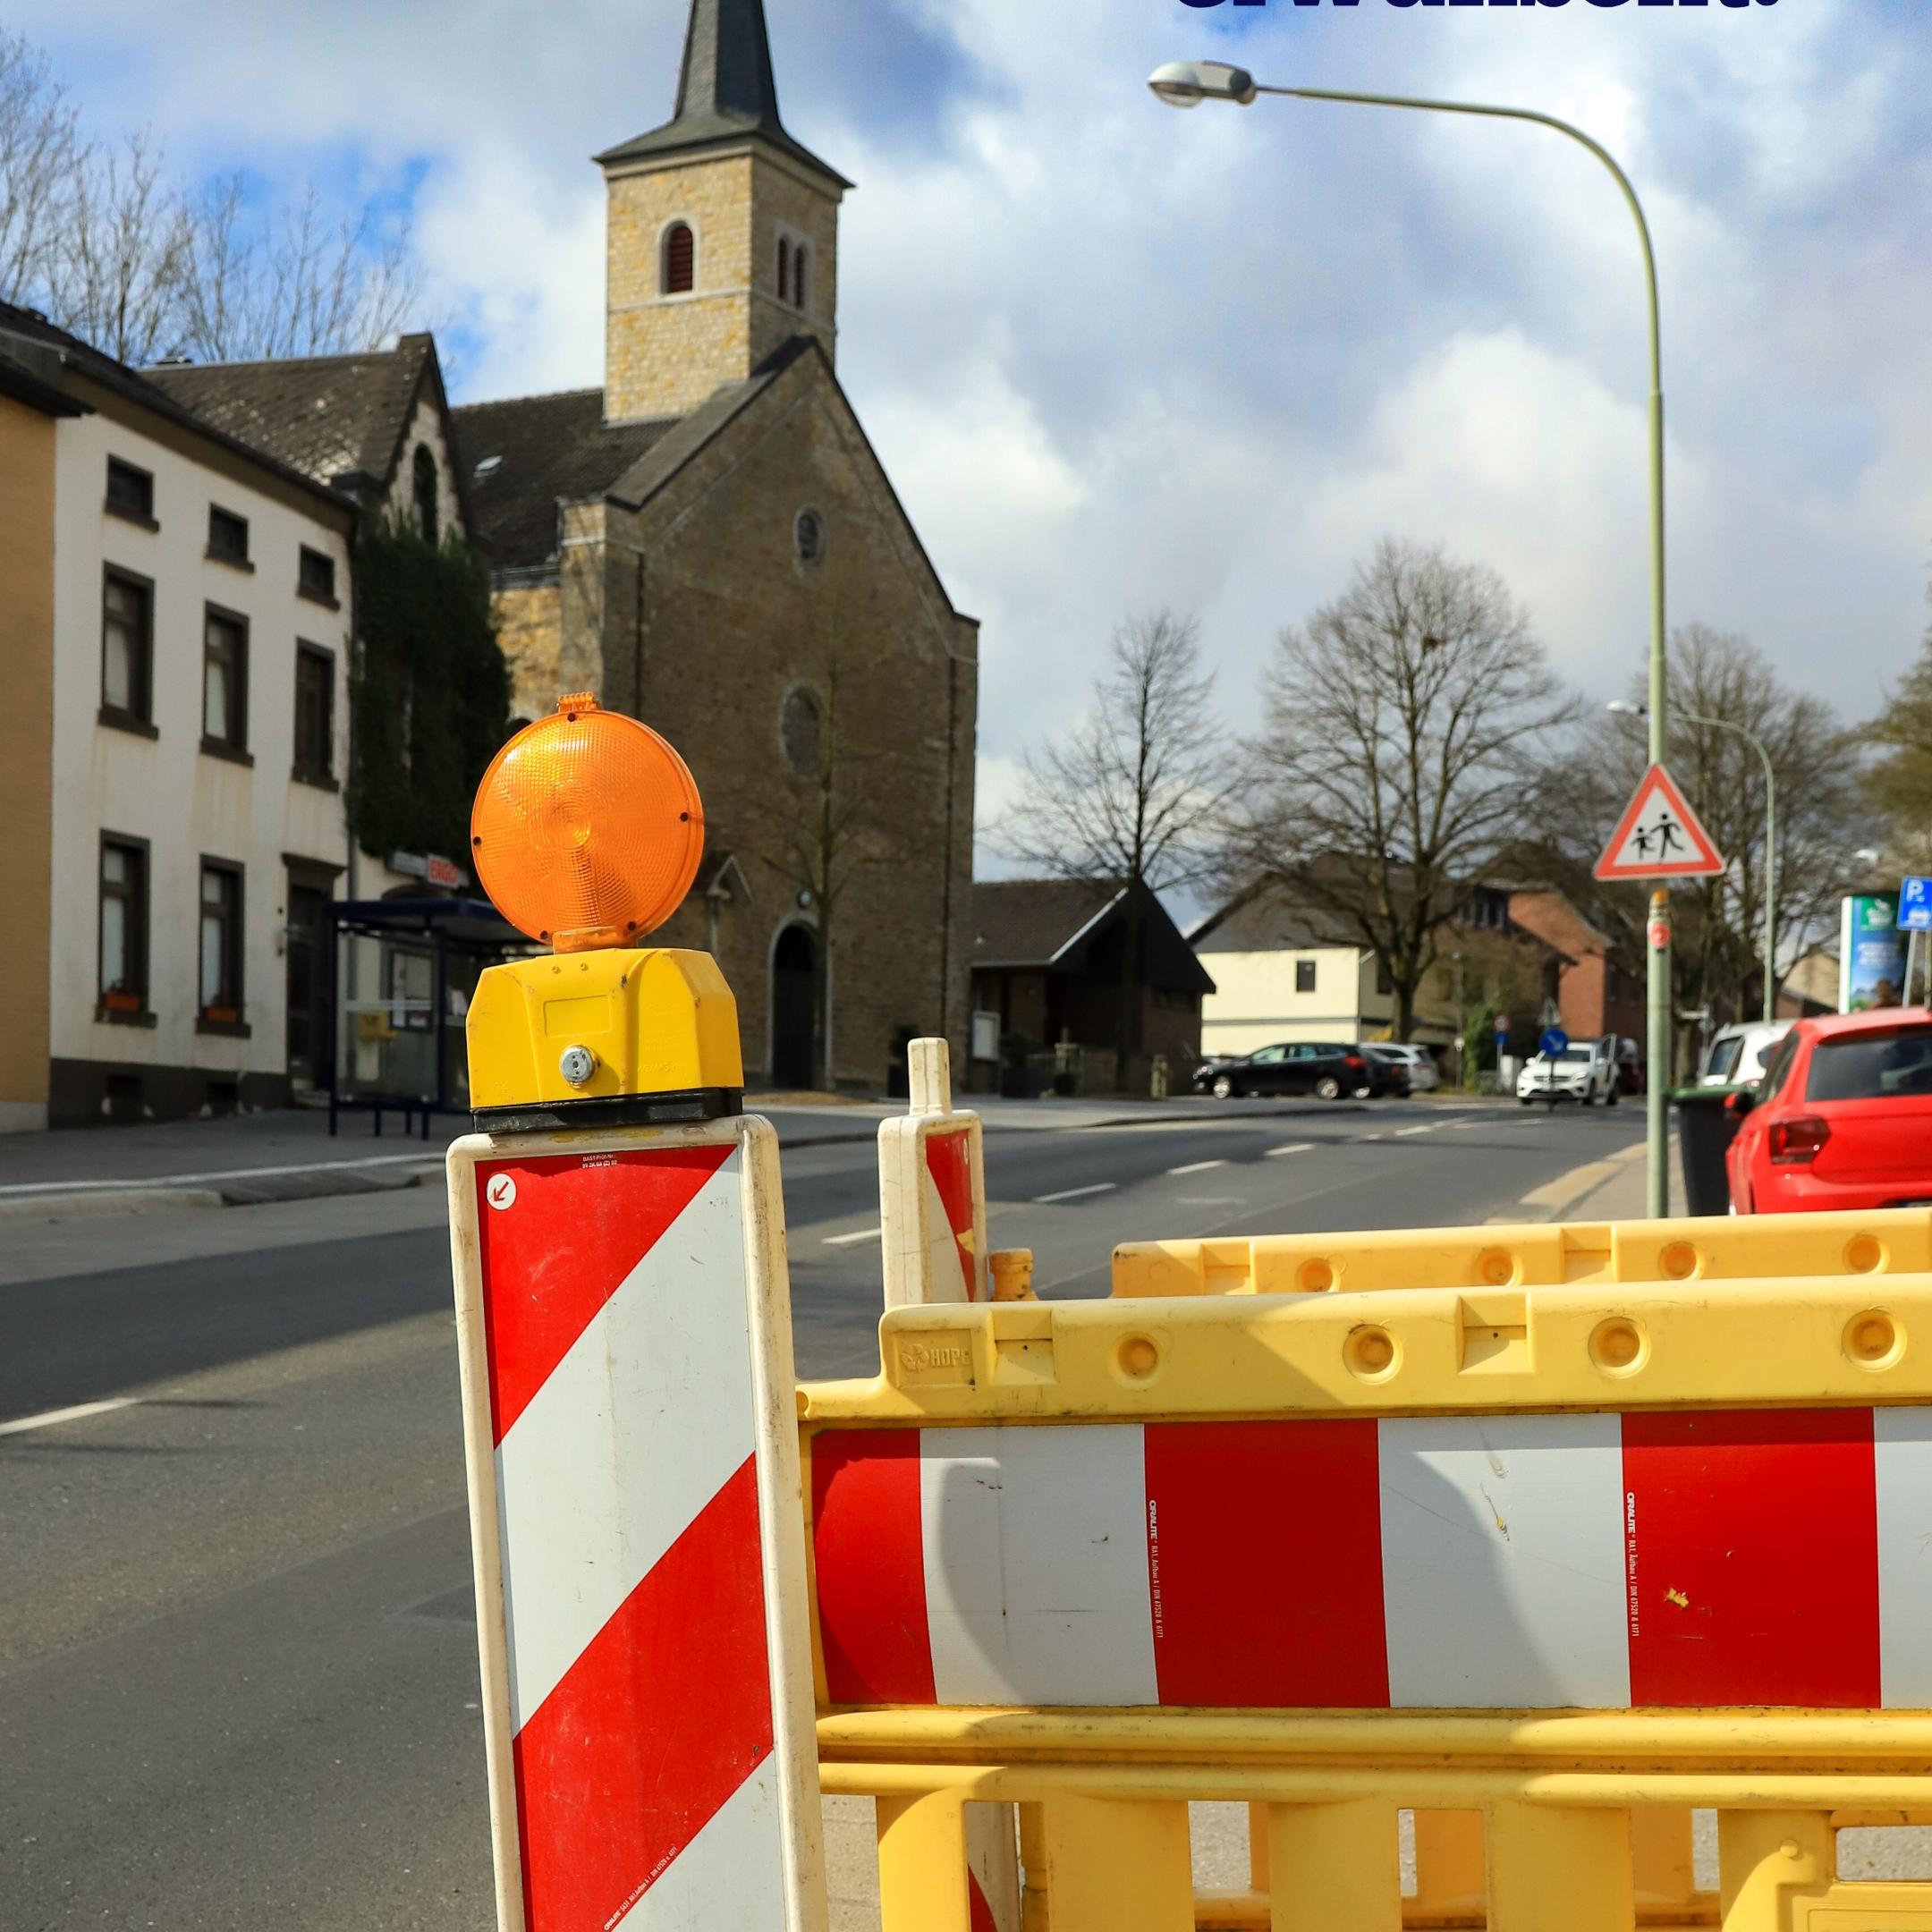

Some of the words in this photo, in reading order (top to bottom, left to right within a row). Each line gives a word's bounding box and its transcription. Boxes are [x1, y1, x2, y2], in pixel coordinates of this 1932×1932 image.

[1906, 879, 1925, 902] P
[1149, 1500, 1157, 1539] ORALITE
[1627, 1492, 1636, 1534] ORALITE
[1631, 1597, 1639, 1615] 67520
